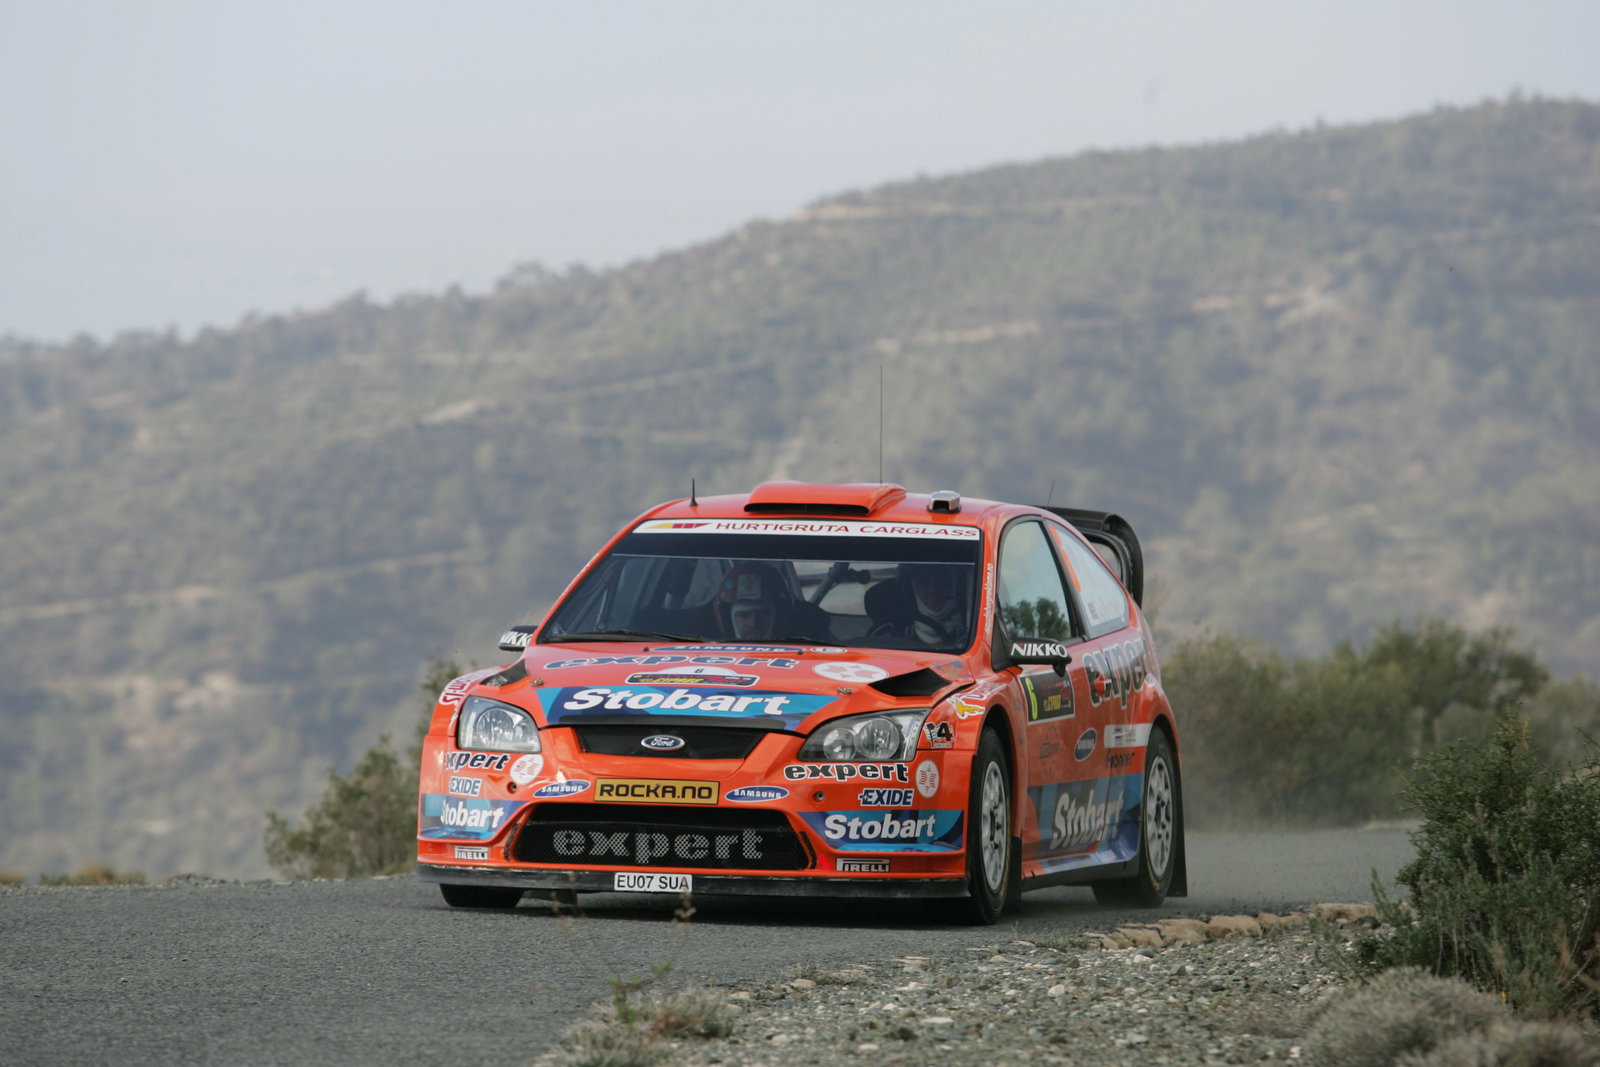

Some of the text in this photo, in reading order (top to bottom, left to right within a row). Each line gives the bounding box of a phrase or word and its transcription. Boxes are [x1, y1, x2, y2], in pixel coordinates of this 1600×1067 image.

[715, 521, 978, 538] HURTIGRUTA CARGLASS
[1011, 643, 1068, 658] NIKKO
[544, 655, 800, 669] expert
[563, 688, 791, 715] Stobart
[1025, 677, 1038, 720] 6
[650, 737, 674, 748] Ford
[445, 751, 511, 773] xpert
[784, 763, 909, 783] expert
[450, 777, 481, 795] EXIDE
[541, 784, 583, 794] SAMSUNG
[734, 789, 782, 799] SAMSUNG
[860, 789, 913, 806] EXIDE
[824, 813, 936, 840] Stobart
[1054, 790, 1123, 849] Stobart
[553, 829, 763, 864] expert
[836, 857, 890, 872] PIRELLI
[617, 875, 689, 890] EU07 SUA
